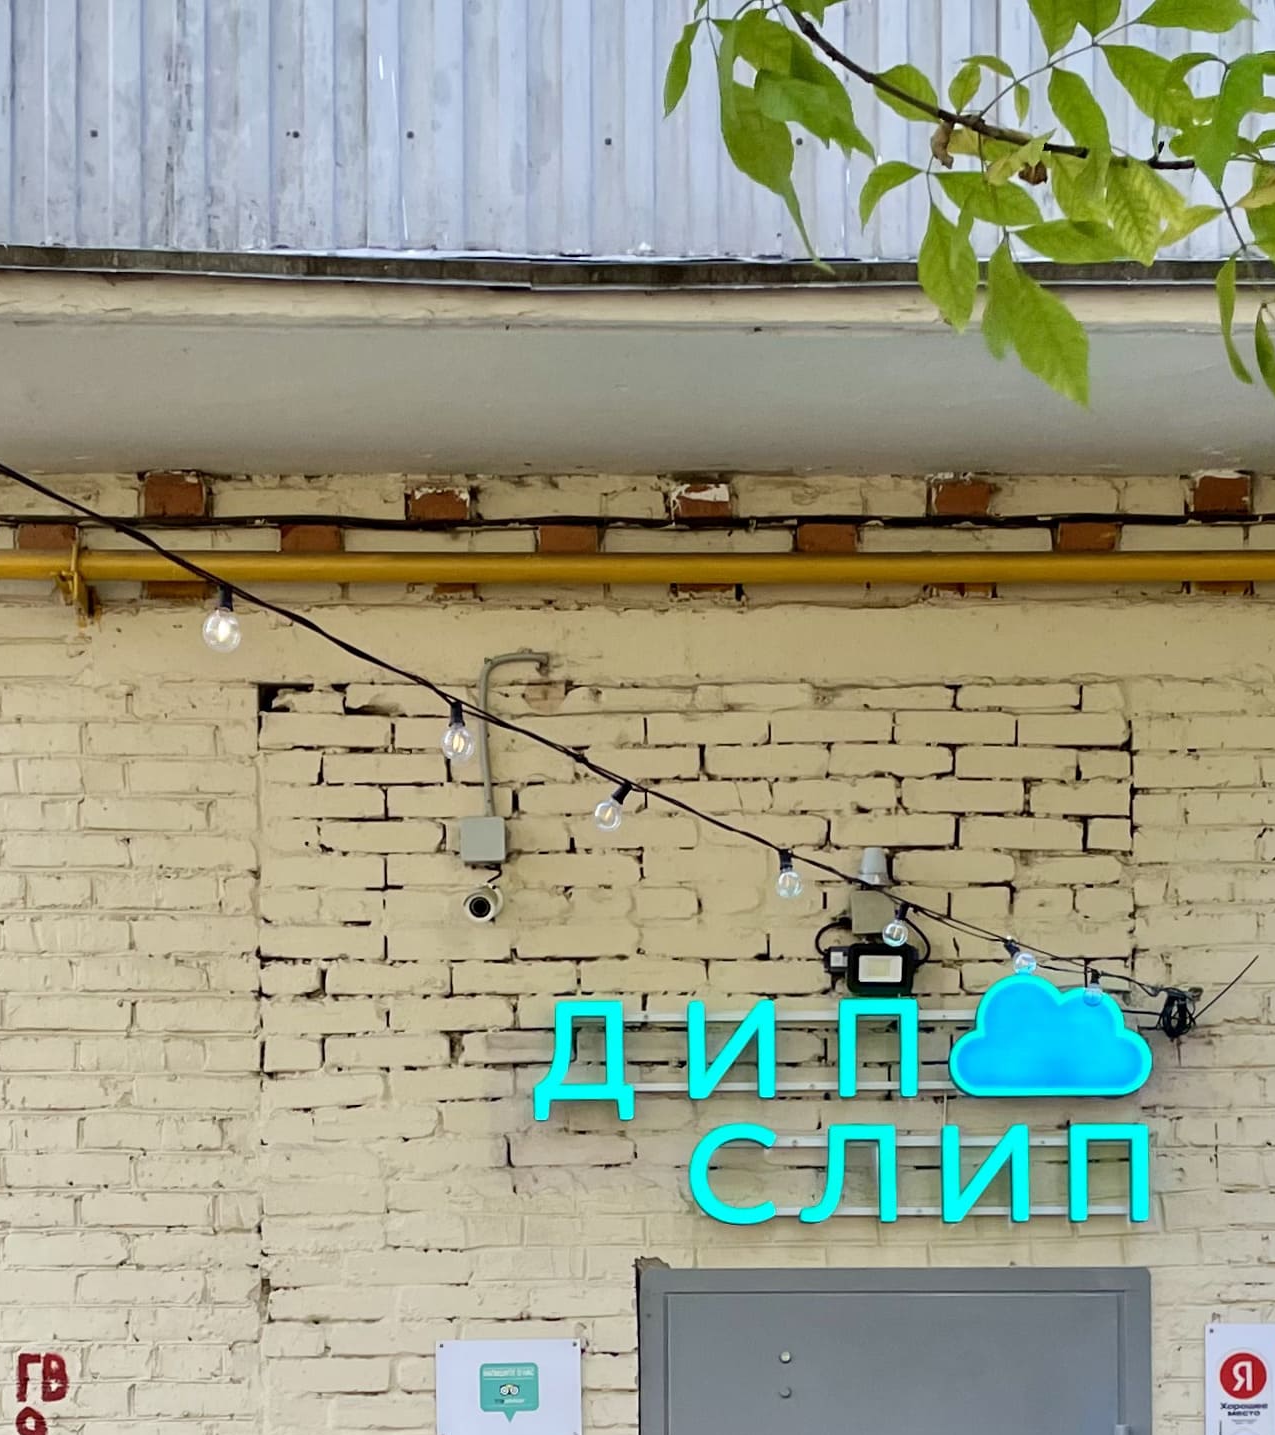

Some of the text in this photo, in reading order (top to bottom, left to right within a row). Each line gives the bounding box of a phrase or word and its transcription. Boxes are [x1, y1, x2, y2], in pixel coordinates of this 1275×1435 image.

[533, 998, 919, 1122] ДИП
[688, 1122, 1151, 1226] СЛИП
[1220, 1402, 1268, 1410] Хорошее
[1232, 1360, 1253, 1392] Я
